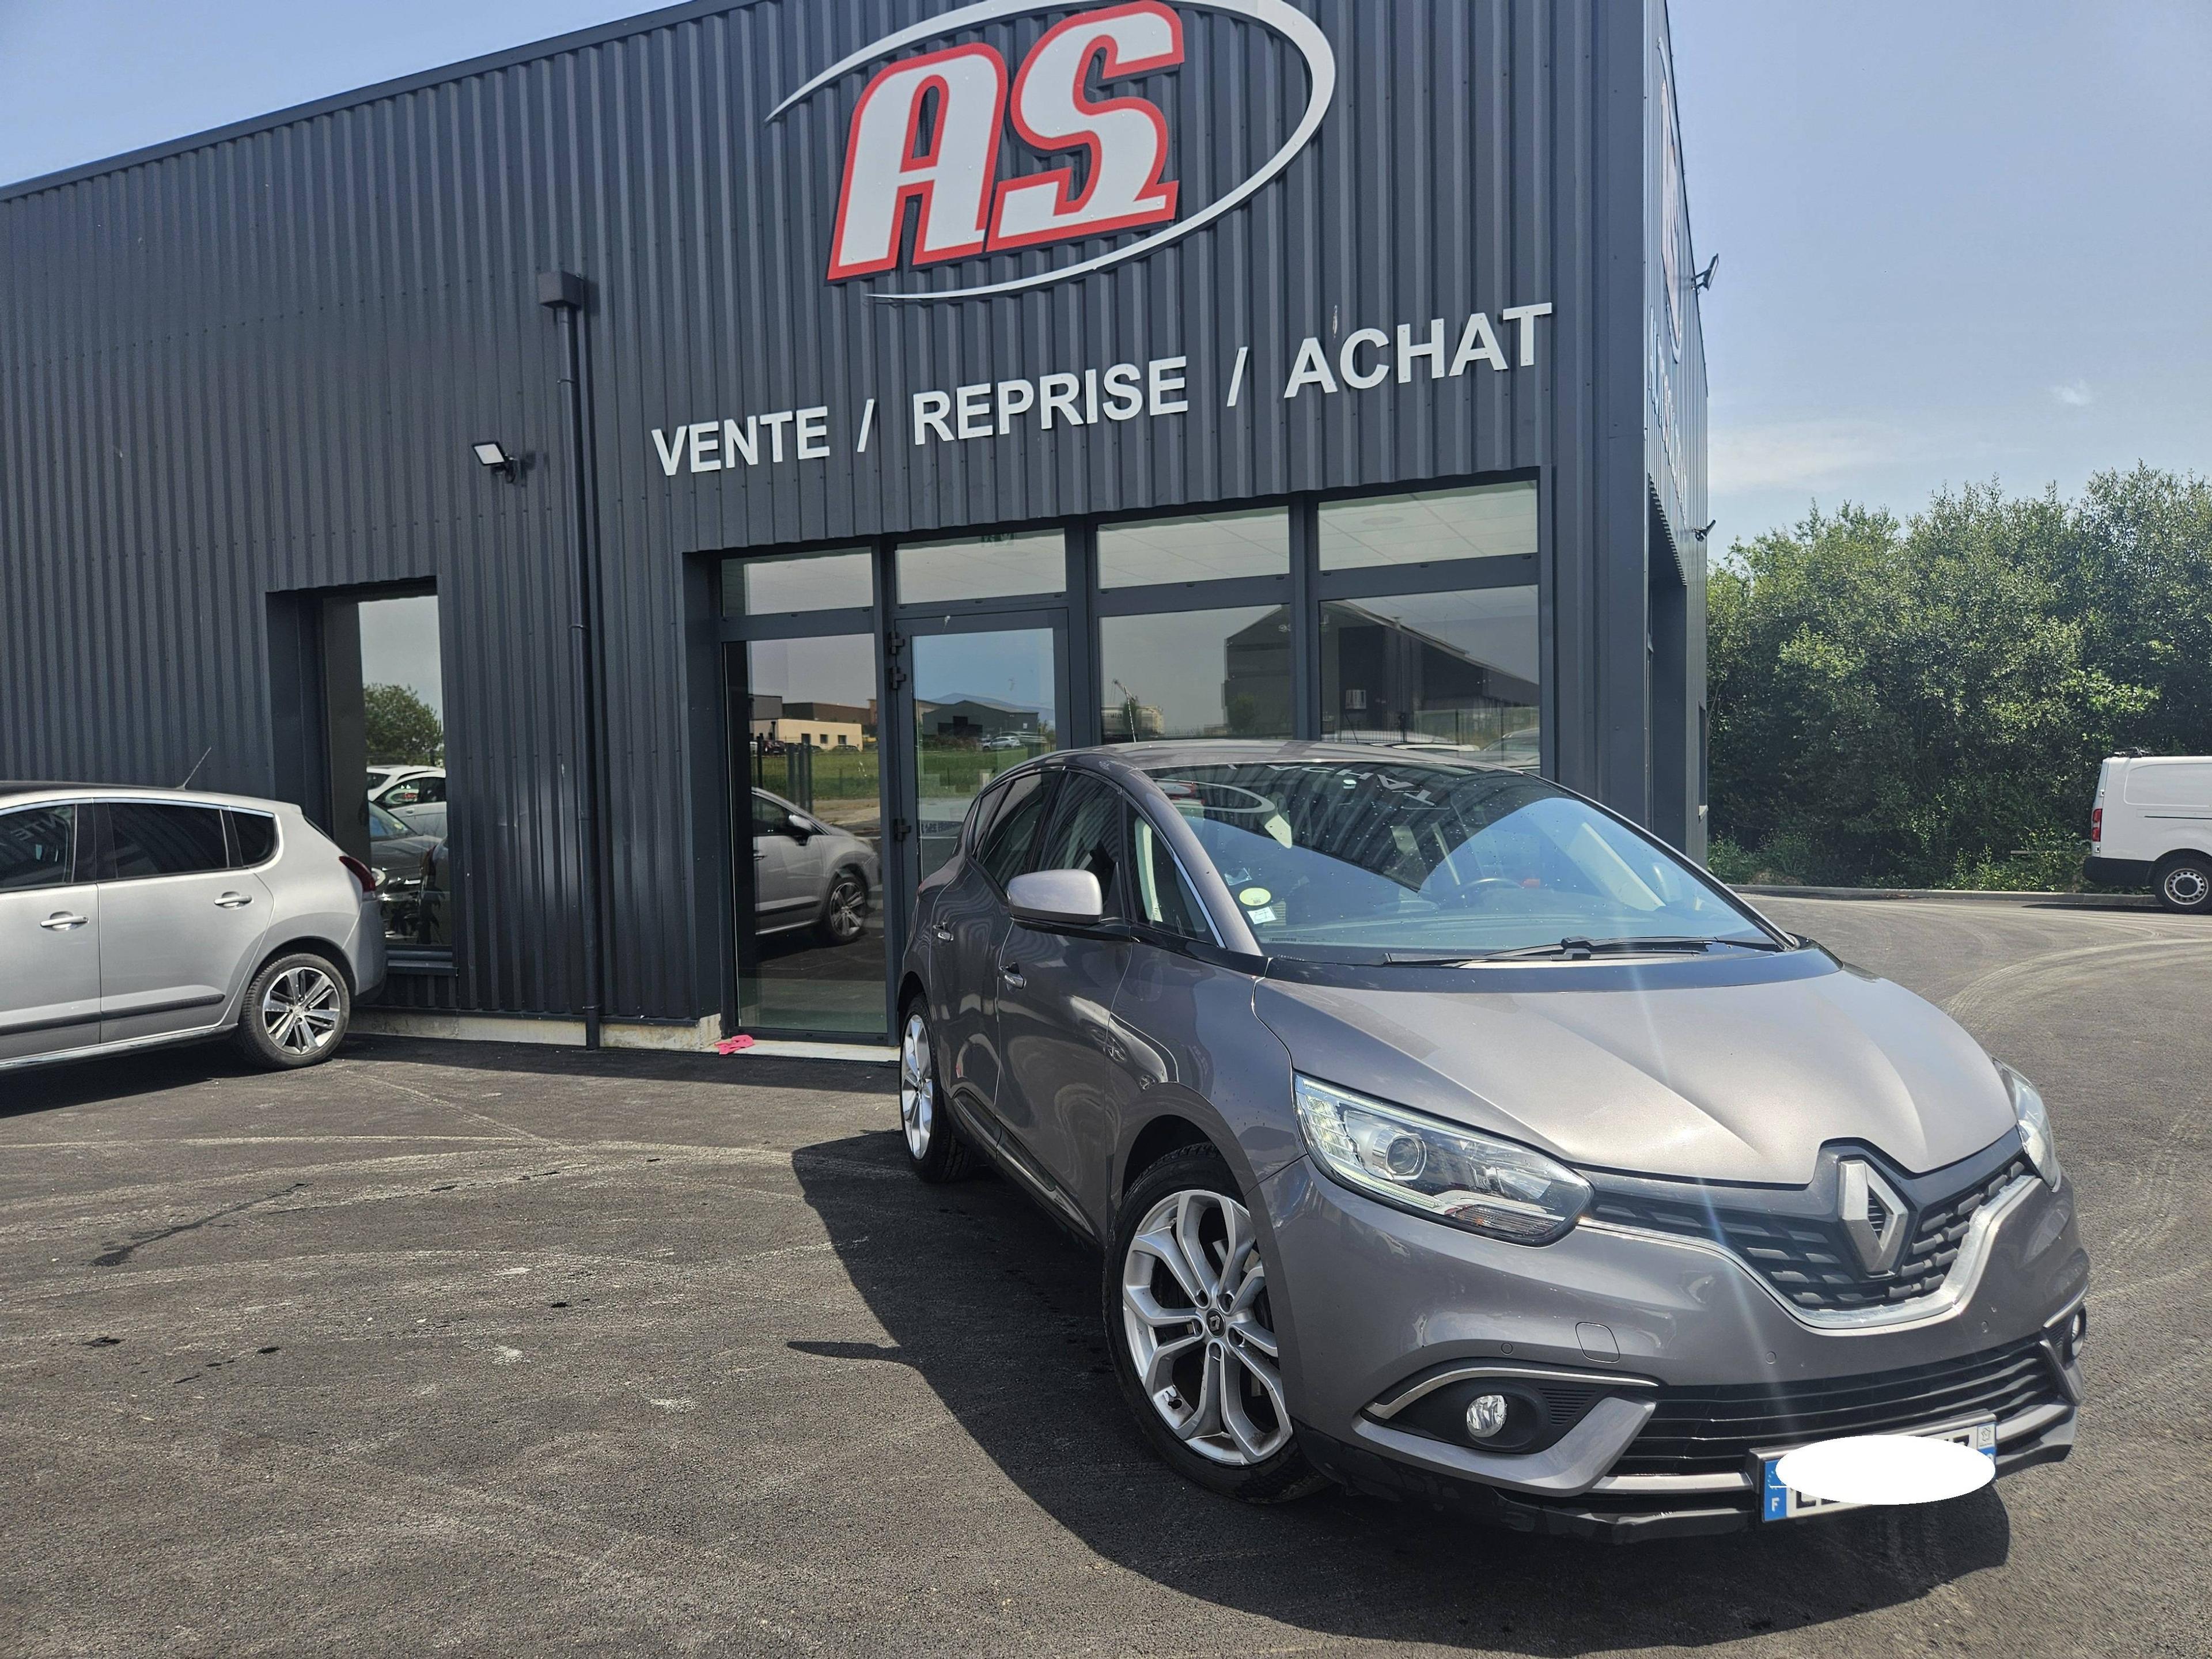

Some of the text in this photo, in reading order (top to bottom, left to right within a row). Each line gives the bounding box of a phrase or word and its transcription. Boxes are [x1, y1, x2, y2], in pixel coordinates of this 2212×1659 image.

[827, 1, 1184, 280] AS
[651, 302, 1552, 476] VENTE / REPRISE / ACHAT
[1771, 1497, 1780, 1512] F
